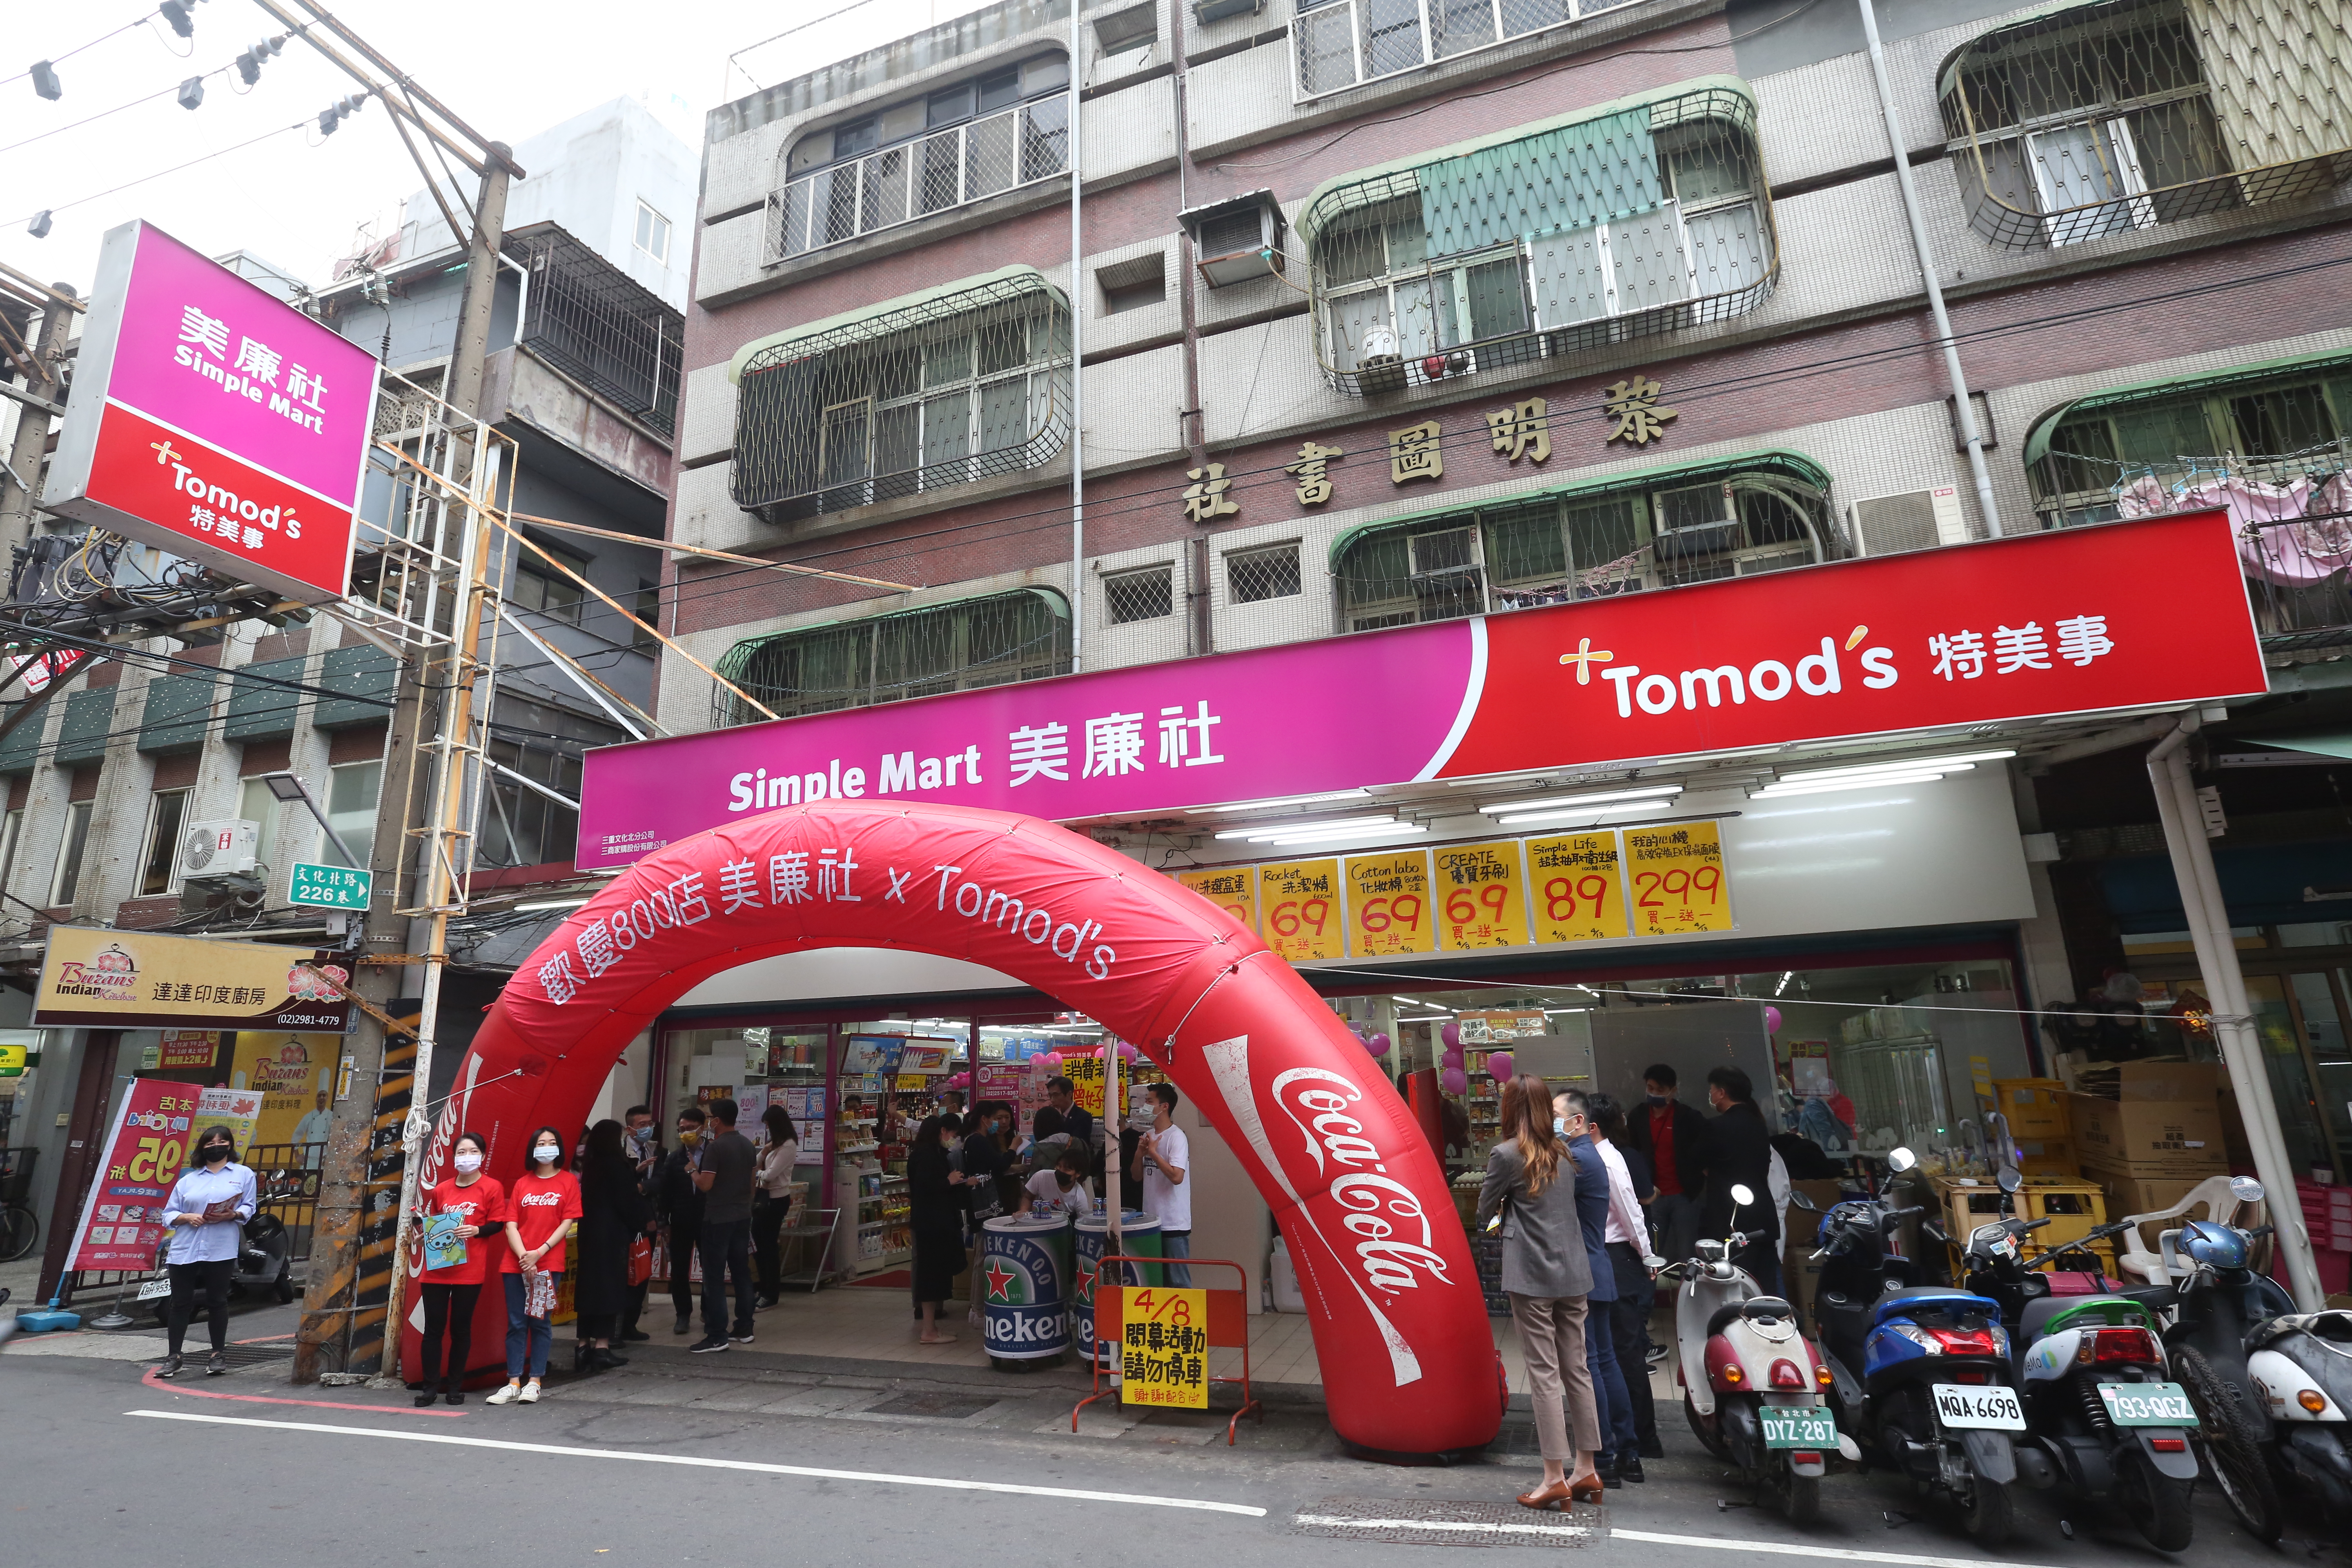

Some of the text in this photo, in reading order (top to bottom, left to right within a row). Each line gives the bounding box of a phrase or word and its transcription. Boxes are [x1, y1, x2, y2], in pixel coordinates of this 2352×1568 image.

[177, 305, 328, 414] 美廉社
[173, 344, 323, 434] Simple Mart
[171, 462, 301, 539] Tomod's
[189, 504, 264, 549] 特美事
[1601, 615, 2114, 719] Tomod's 特美事
[728, 699, 1224, 811] Simple Mart 美廉社
[601, 840, 667, 856] 三商家購股份有限公司
[602, 832, 654, 845] 三重文化北分公司
[1533, 838, 1597, 855] Simple Life
[1631, 830, 1688, 847] 我的心機
[1439, 851, 1497, 869] CREATE
[1538, 850, 1618, 868] 超柔抽取衛生紙
[296, 867, 357, 886] 文化北路
[1264, 869, 1302, 882] Rocket
[1351, 861, 1419, 880] Cotton labo
[1450, 864, 1508, 884] 優質牙刷
[1282, 874, 1328, 893] 洗潔精
[1635, 866, 1720, 907] 299
[298, 885, 350, 904] 226巷
[1446, 884, 1508, 924] 69
[1545, 875, 1607, 921] 89
[719, 847, 862, 915] 美廉社
[934, 865, 1116, 980] Tomod's
[1271, 899, 1329, 936] 69
[1361, 894, 1421, 933] 69
[1648, 909, 1712, 924] 買一送一
[1364, 933, 1415, 947] 買一送一
[1452, 924, 1508, 940] 買一送一
[1274, 938, 1324, 952] 買一送一
[56, 984, 137, 1001] Indian Kitchen
[152, 982, 266, 1005] 達達印度廚房
[278, 1014, 339, 1025] (02)2981-4779
[1463, 1021, 1485, 1029] 會員卡
[252, 1080, 283, 1091] Indian
[260, 1099, 301, 1109] 達印度料理
[1272, 1067, 1455, 1295] Coca-Cola
[521, 1191, 562, 1207] Coca-Cola
[430, 1256, 447, 1266] Qoo
[1134, 1289, 1191, 1326] 4/8
[1125, 1322, 1205, 1355] 開幕活動
[1124, 1352, 1202, 1389] 請勿停車
[1134, 1388, 1186, 1404] 謝謝配合
[2105, 1396, 2196, 1419] 793-QGZ
